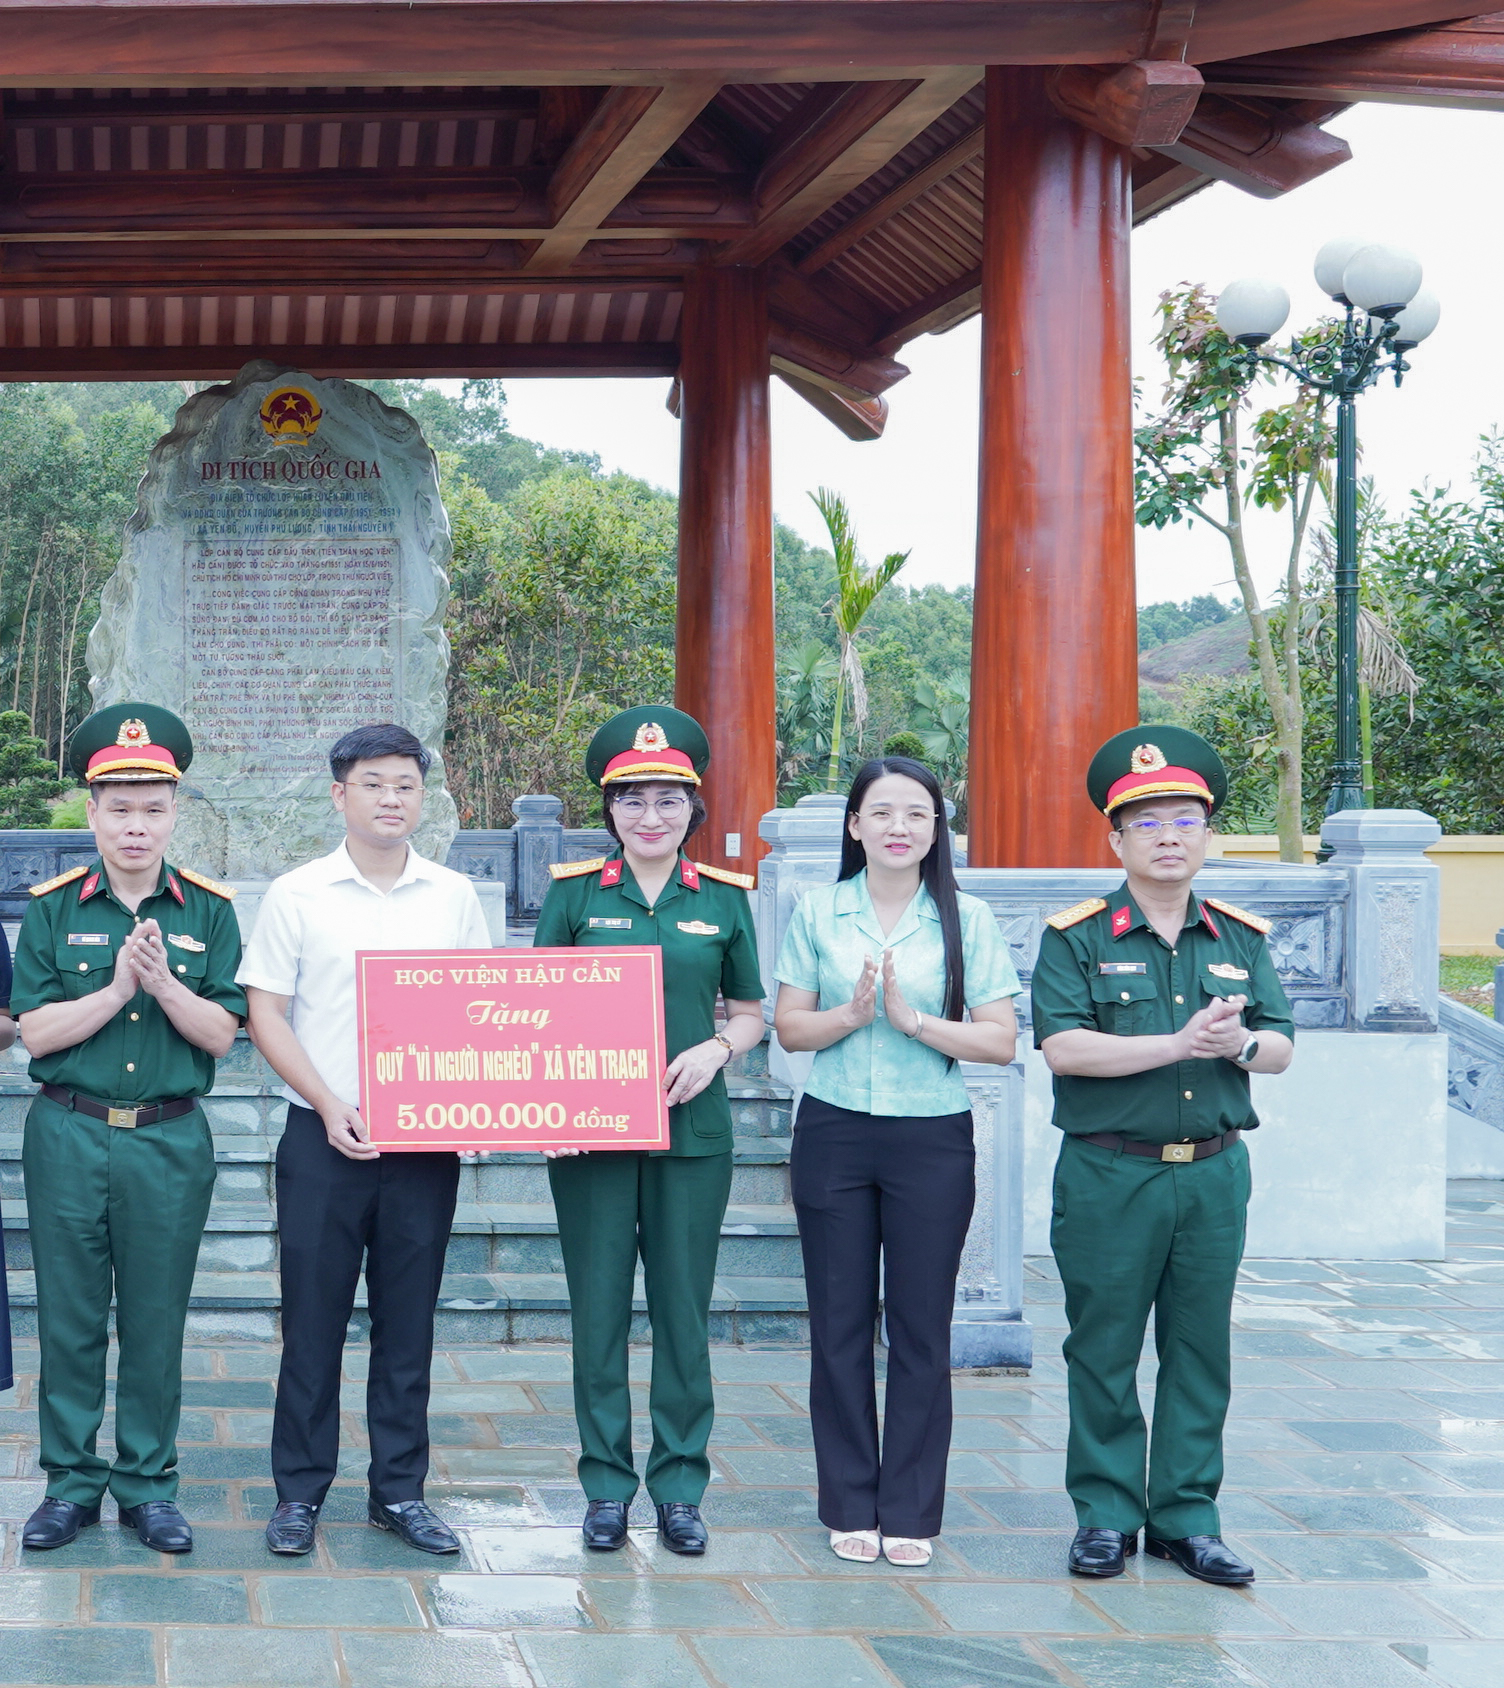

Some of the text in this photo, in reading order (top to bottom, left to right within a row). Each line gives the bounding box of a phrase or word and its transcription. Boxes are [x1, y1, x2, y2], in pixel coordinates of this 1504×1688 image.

[202, 449, 382, 484] DI TÍCH QUỐC GIA
[394, 959, 622, 989] HỌC VIỆN HẬU CẦN
[465, 1000, 553, 1031] Tặng
[376, 1045, 404, 1086] QUỸ
[434, 1044, 479, 1082] NGƯỜI
[543, 1044, 565, 1081] XÃ
[567, 1043, 596, 1080] YÊN
[600, 1049, 648, 1086] TRẠCH
[397, 1102, 630, 1132] 5.000.000 đồng
